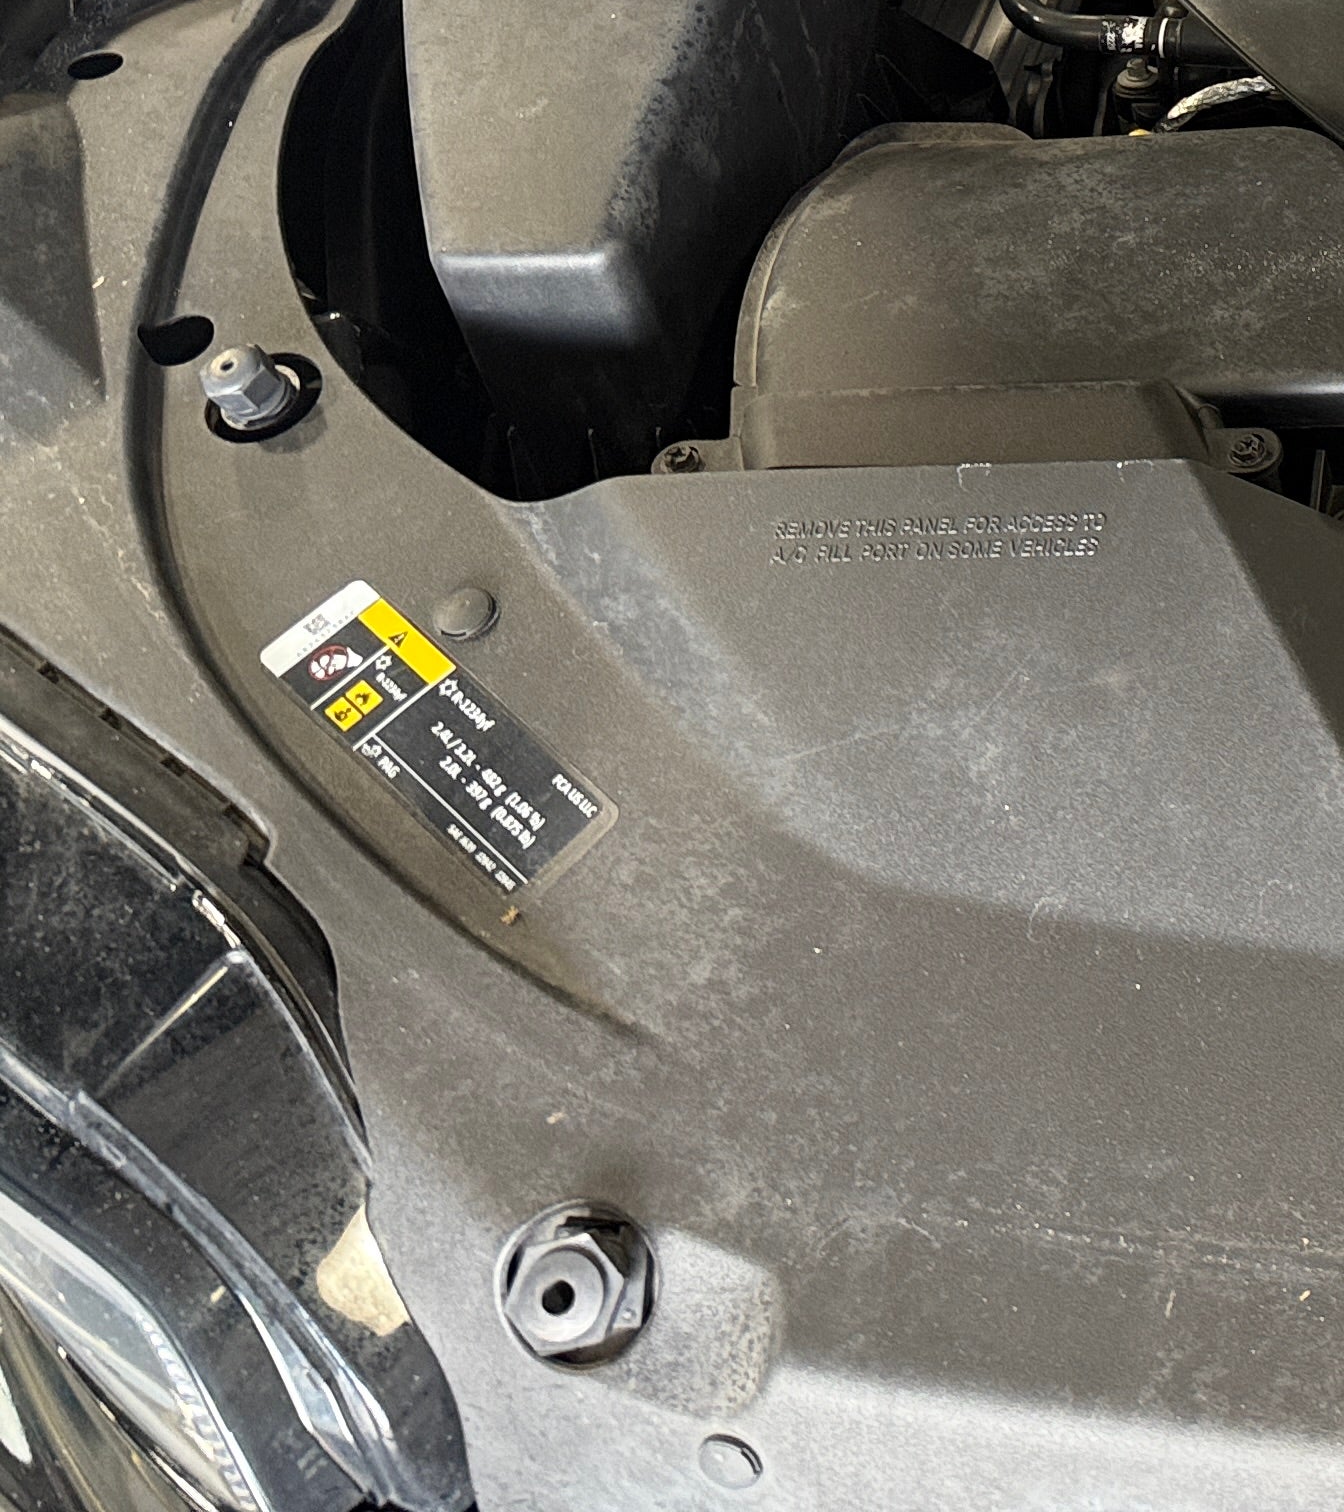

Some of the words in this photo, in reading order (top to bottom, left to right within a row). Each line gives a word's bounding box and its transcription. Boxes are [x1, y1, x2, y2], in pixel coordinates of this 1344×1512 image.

[774, 520, 851, 539] REMOVE
[855, 518, 897, 537] THIS
[900, 516, 958, 536] PANEL
[963, 515, 1003, 534] FOR
[1003, 513, 1079, 533] ACCESS
[1083, 512, 1107, 531] TO
[769, 545, 807, 565] A/C
[814, 544, 852, 563] FILL
[859, 543, 909, 562] PORT
[916, 541, 944, 561] ON
[947, 539, 1003, 559] SOME
[1009, 536, 1100, 557] VEHICLES
[451, 691, 495, 731] R-1234yf
[378, 756, 400, 779] PAG
[552, 774, 574, 795] FCA
[568, 788, 584, 805] US
[577, 799, 597, 818] LLC
